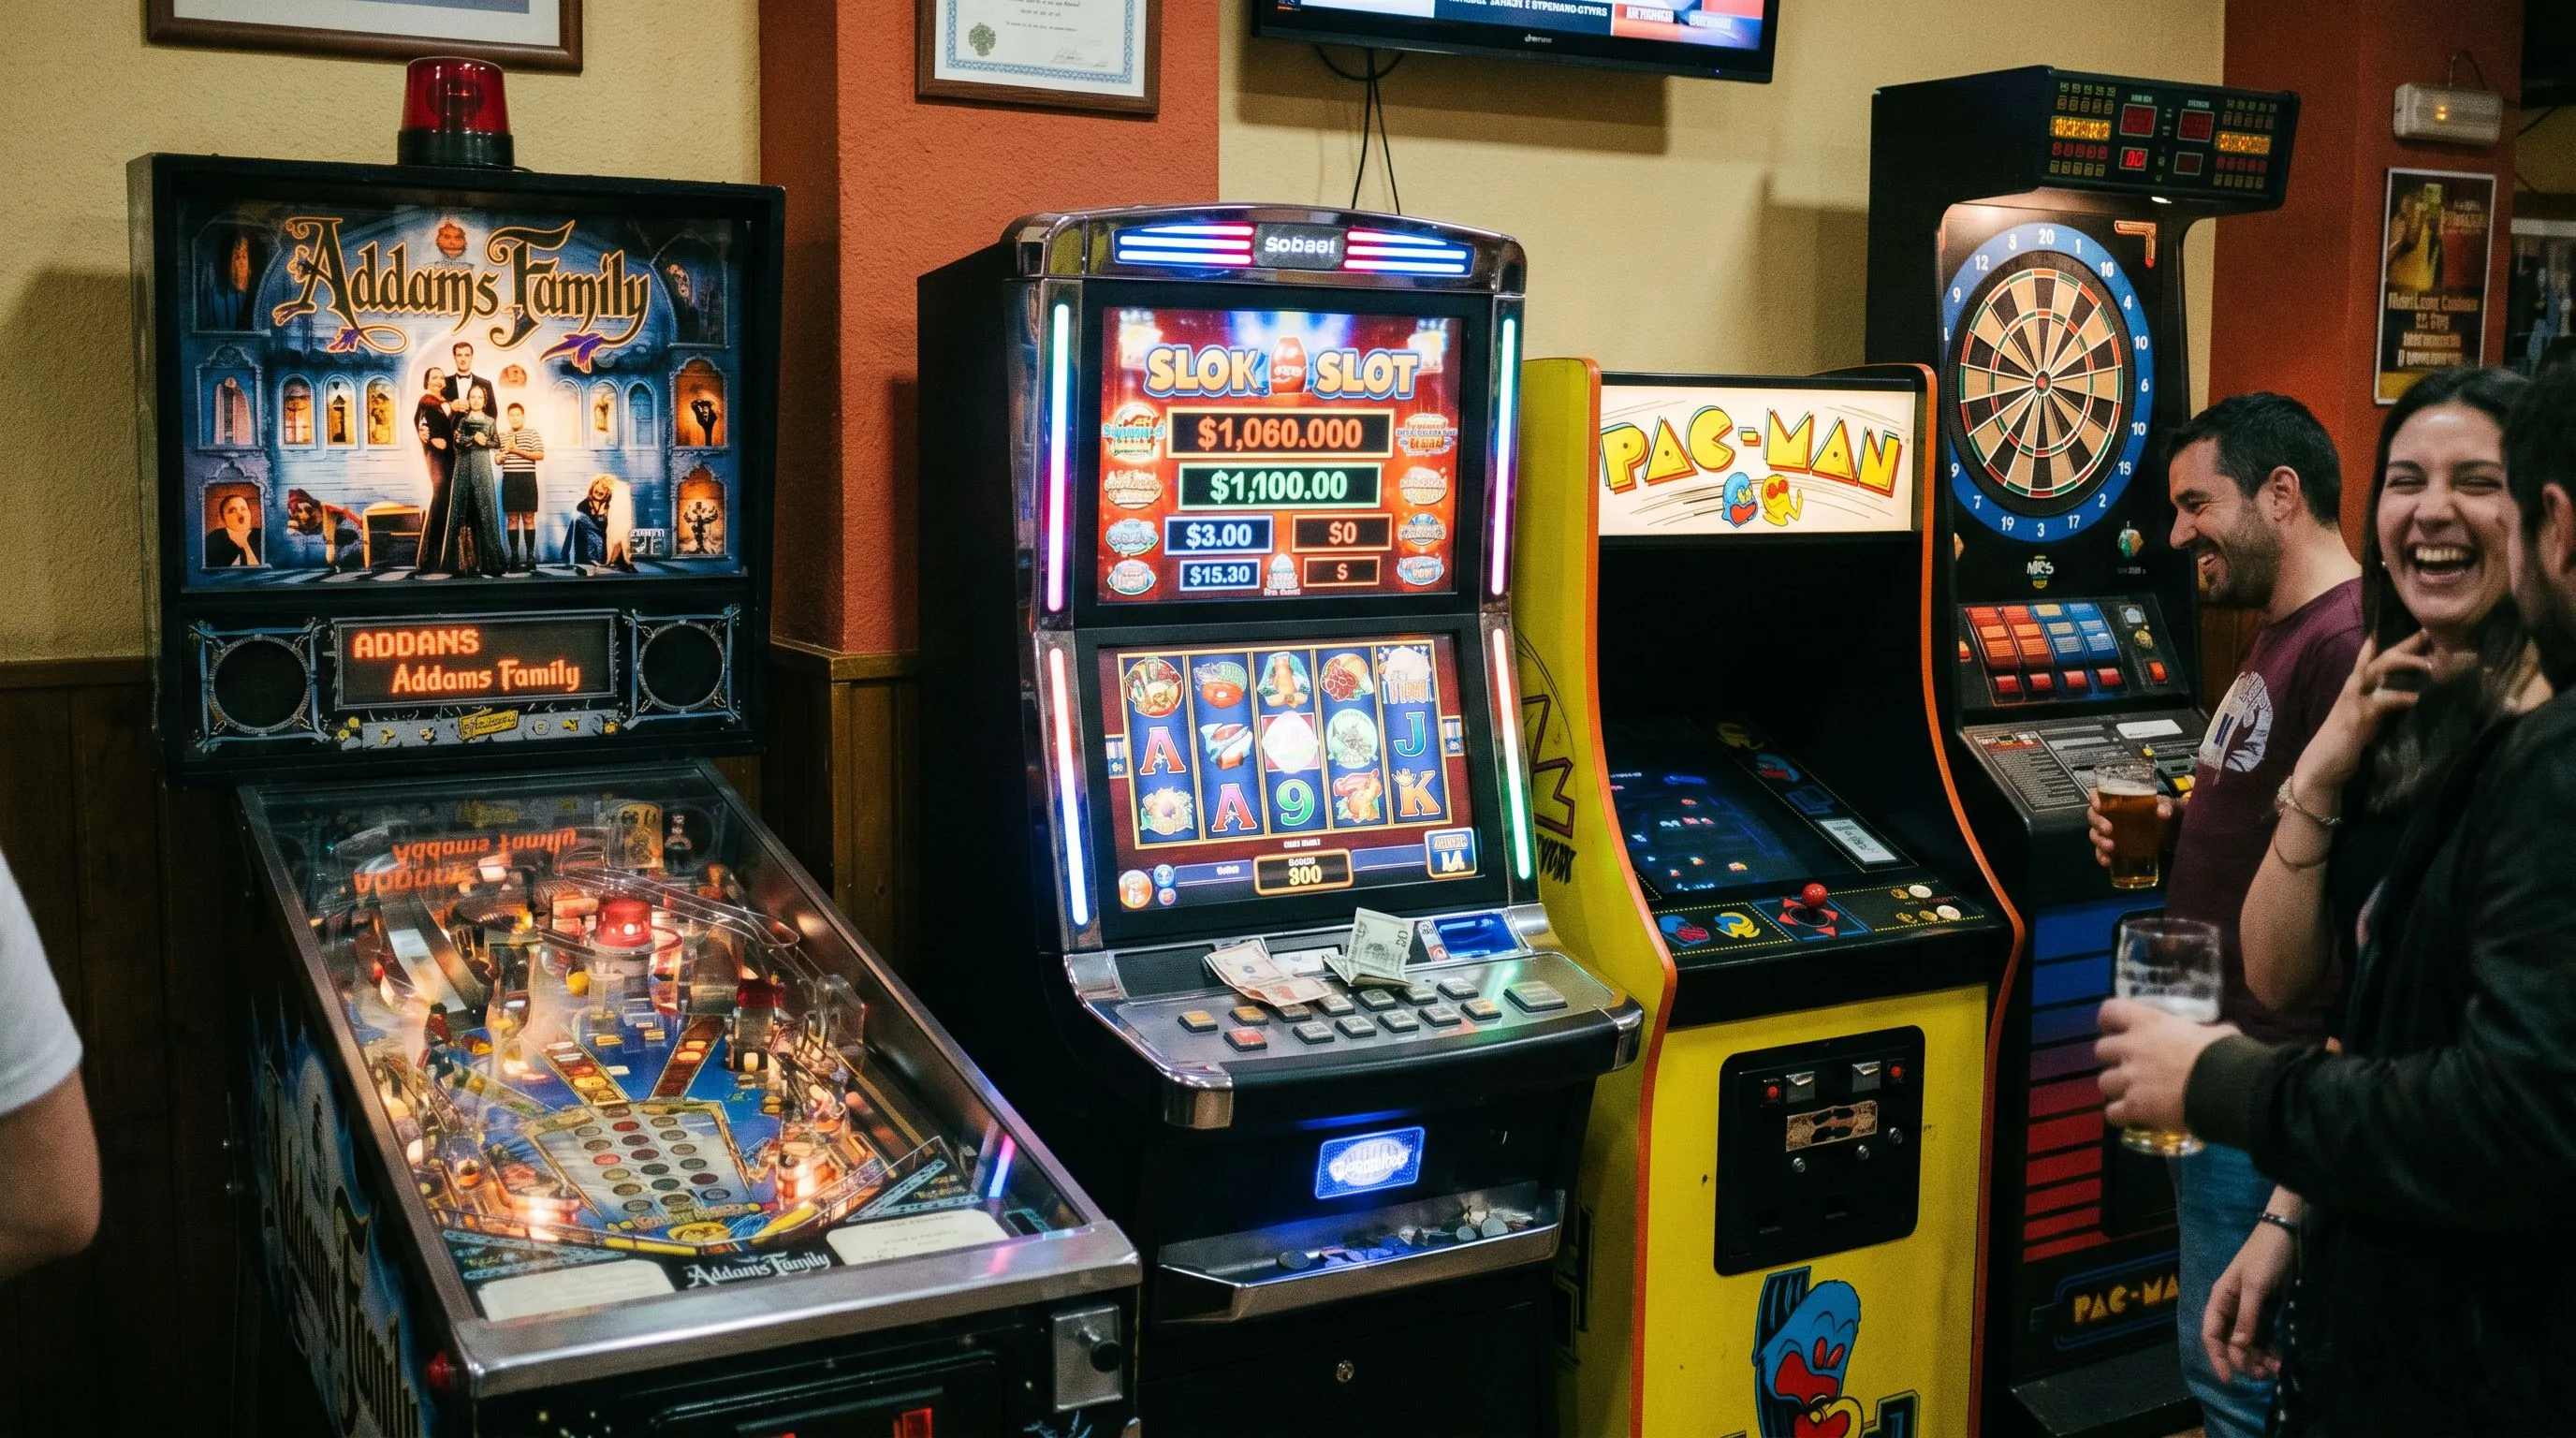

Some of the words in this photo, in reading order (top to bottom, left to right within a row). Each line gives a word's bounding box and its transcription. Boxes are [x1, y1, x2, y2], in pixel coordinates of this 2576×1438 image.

[2039, 228, 2056, 245] 20
[2075, 238, 2082, 255] 1
[1974, 255, 1989, 271] 12
[271, 216, 502, 354] Addams
[485, 219, 651, 365] Family
[1953, 286, 1962, 303] 9
[2123, 295, 2132, 311] 4
[2134, 335, 2149, 351] 10
[1144, 344, 1263, 398] SLOK
[1311, 347, 1423, 400] SLOT
[2140, 378, 2149, 393] 6
[1197, 417, 1364, 451] $1,060.000
[2131, 421, 2146, 436] 10
[1600, 405, 1903, 498] PAC-MAN
[1951, 462, 1960, 478] 9
[1210, 469, 1348, 504] $1,100.00
[1973, 494, 1983, 509] 7
[2099, 493, 2106, 508] 2
[1328, 521, 1357, 546] $0
[2000, 516, 2015, 532] 19
[2037, 522, 2045, 538] 3
[2068, 515, 2081, 529] 17
[1186, 523, 1252, 550] $3.00
[1190, 565, 1251, 587] $15.30
[354, 628, 480, 659] ADDANS
[391, 664, 492, 695] Addams
[497, 658, 581, 693] Family
[1393, 711, 1427, 758] J
[1139, 726, 1188, 776] A
[1276, 778, 1315, 827] 9
[1398, 770, 1442, 818] K
[1213, 783, 1257, 832] A
[681, 1263, 772, 1289] Addams
[760, 1251, 832, 1278] Family
[2073, 1273, 2179, 1325] PAC-MA
